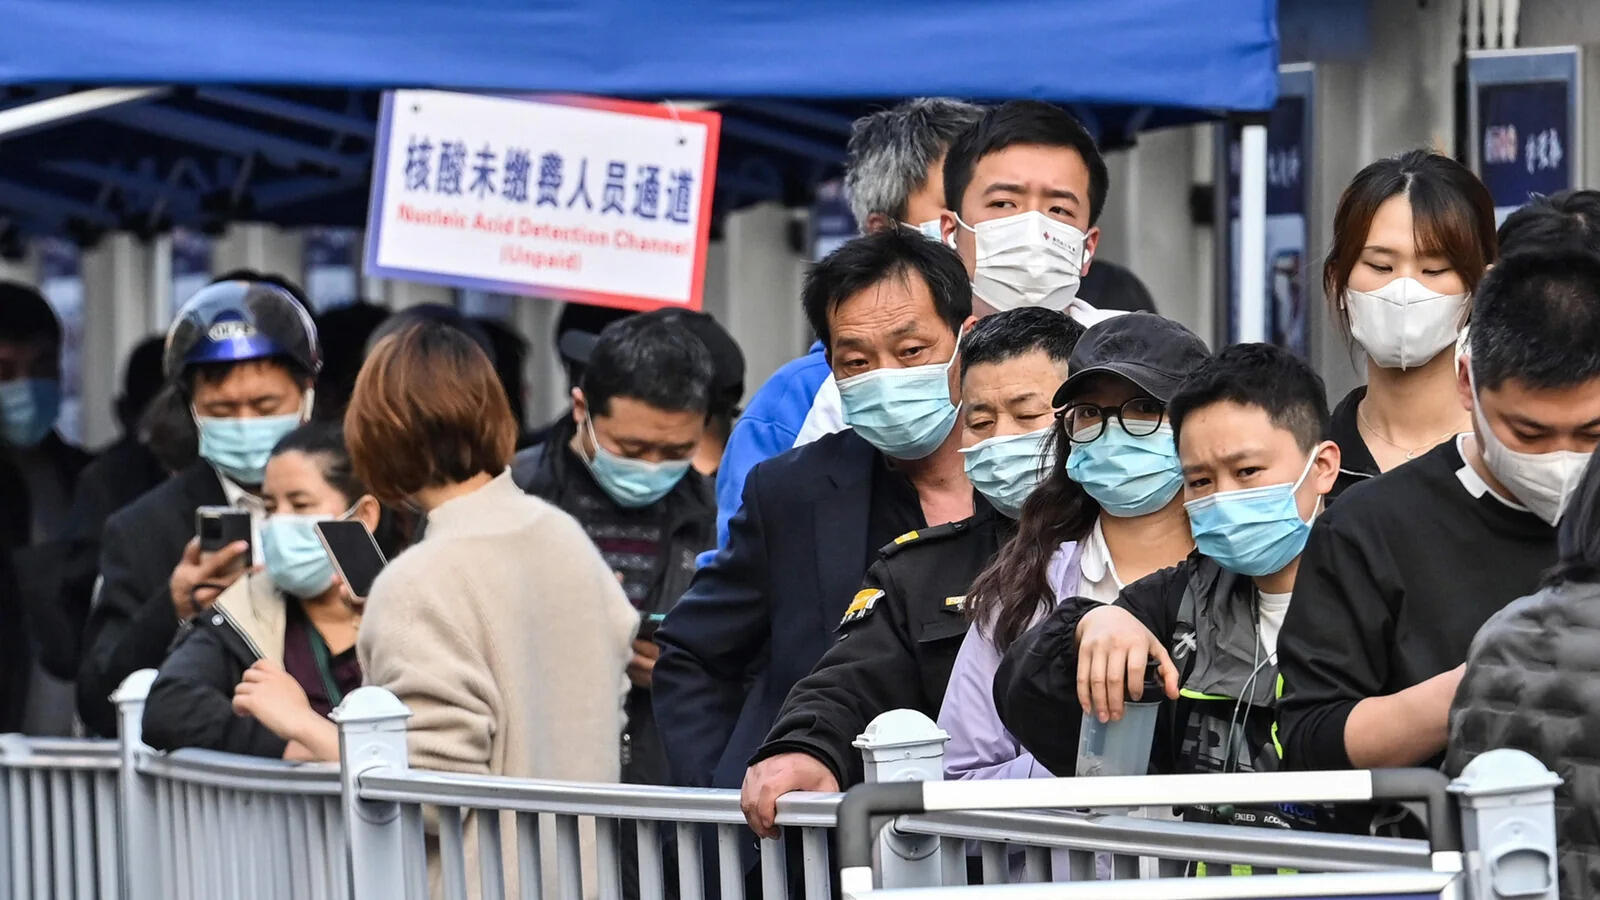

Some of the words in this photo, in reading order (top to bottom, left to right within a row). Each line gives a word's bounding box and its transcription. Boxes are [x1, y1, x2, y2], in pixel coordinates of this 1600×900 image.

[404, 136, 693, 224] 核酸未缴费人员通道
[398, 202, 466, 228] Nucleic
[472, 212, 515, 235] Acid
[517, 217, 609, 246] Detection
[615, 230, 688, 256] Channel
[501, 244, 581, 272] (Unpaid)
